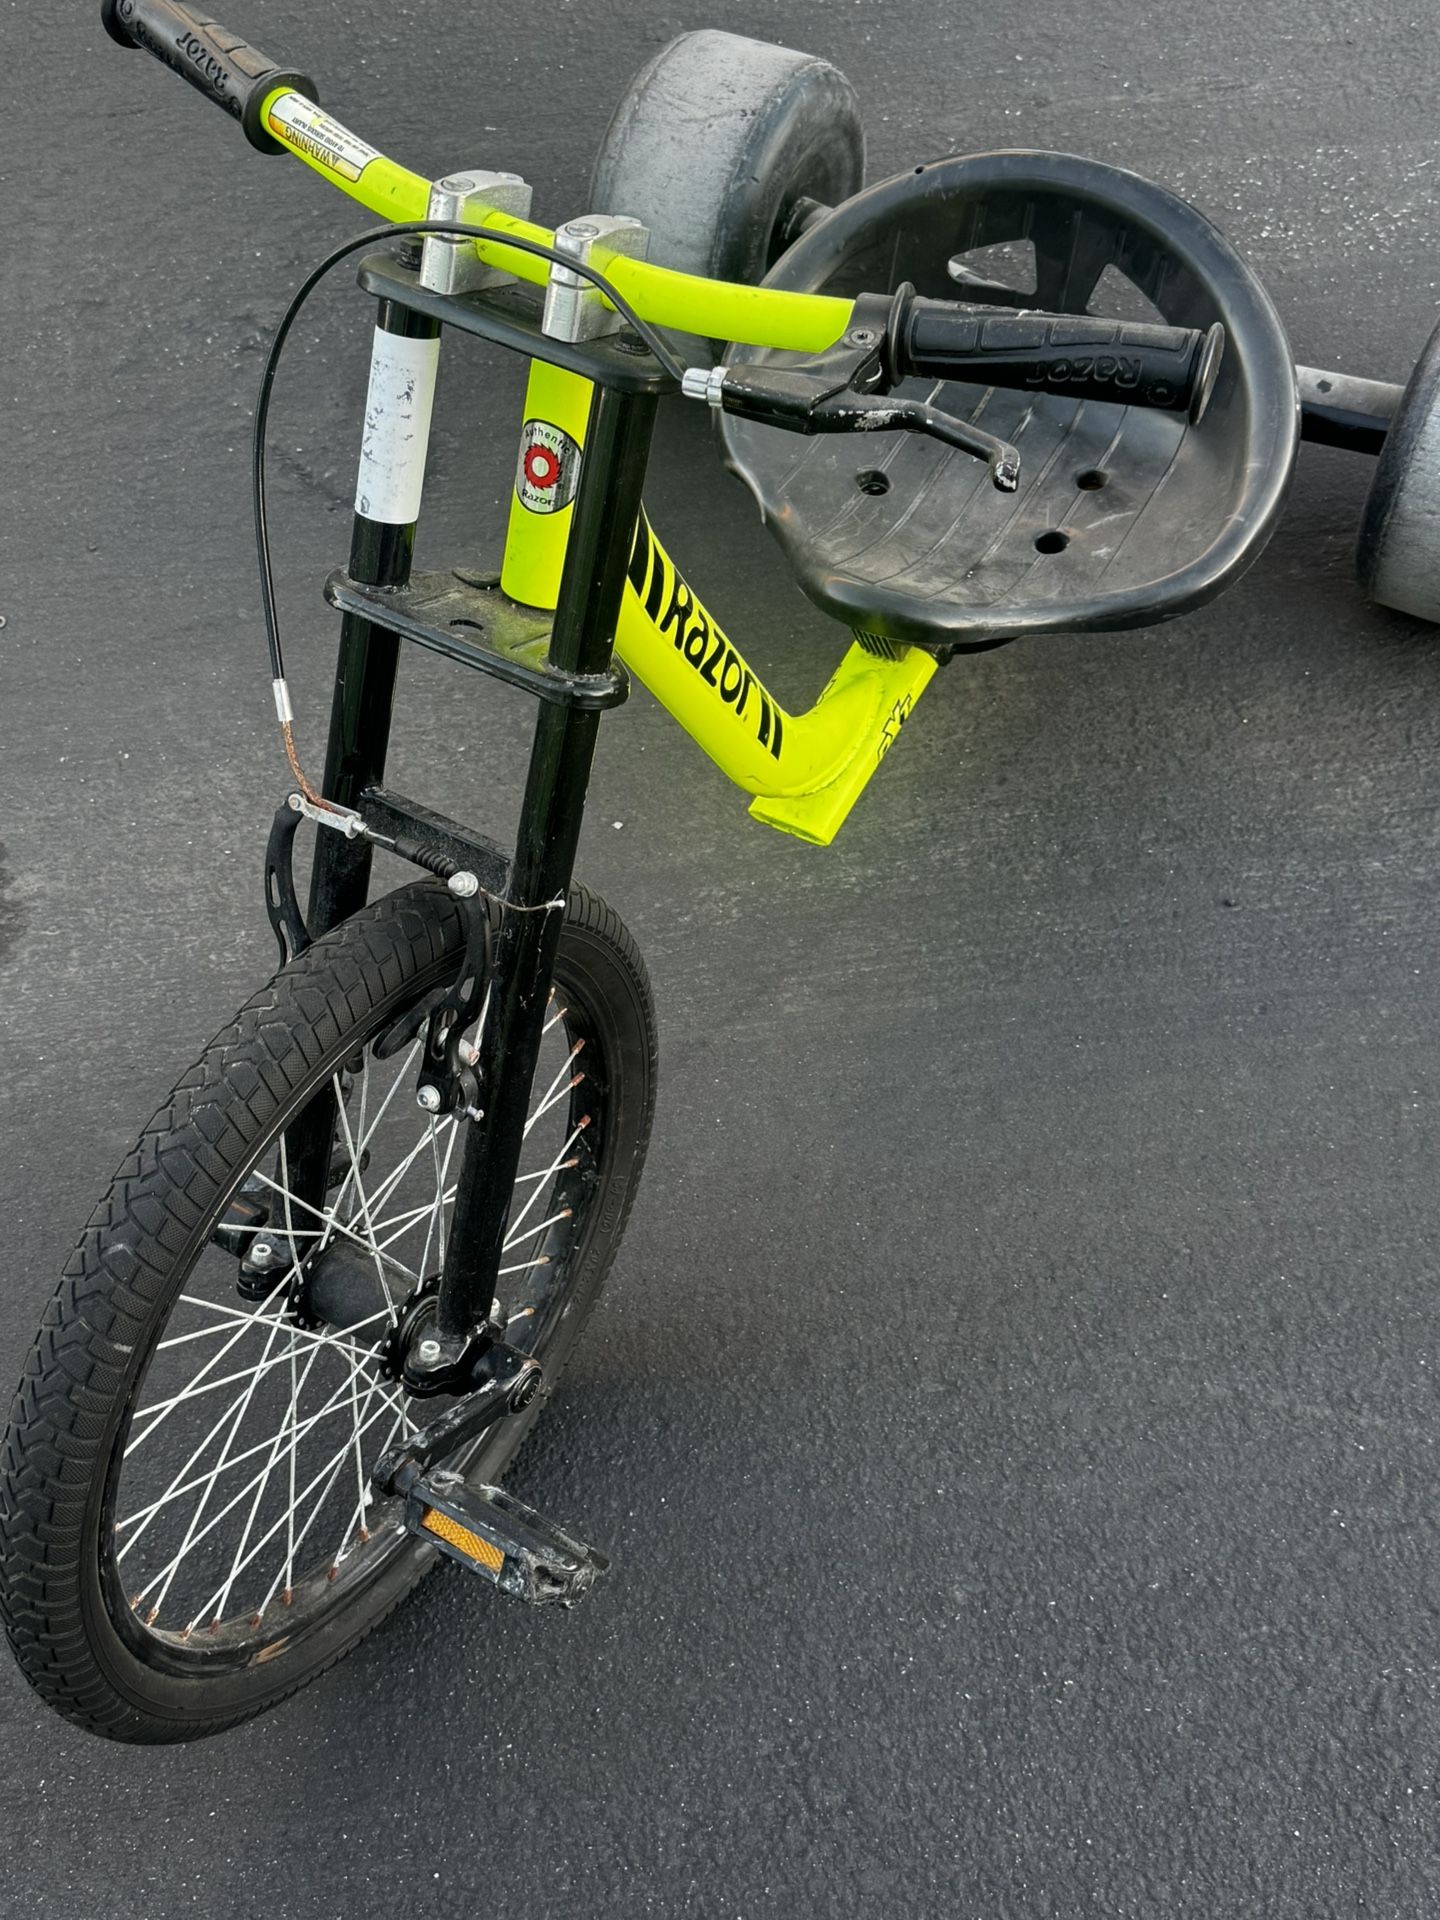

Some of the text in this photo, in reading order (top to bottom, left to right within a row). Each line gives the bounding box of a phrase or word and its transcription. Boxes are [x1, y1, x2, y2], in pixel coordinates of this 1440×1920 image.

[285, 126, 333, 165] WARNING
[1026, 356, 1143, 389] Razor
[525, 427, 571, 455] Authentic
[659, 564, 757, 717] Razor
